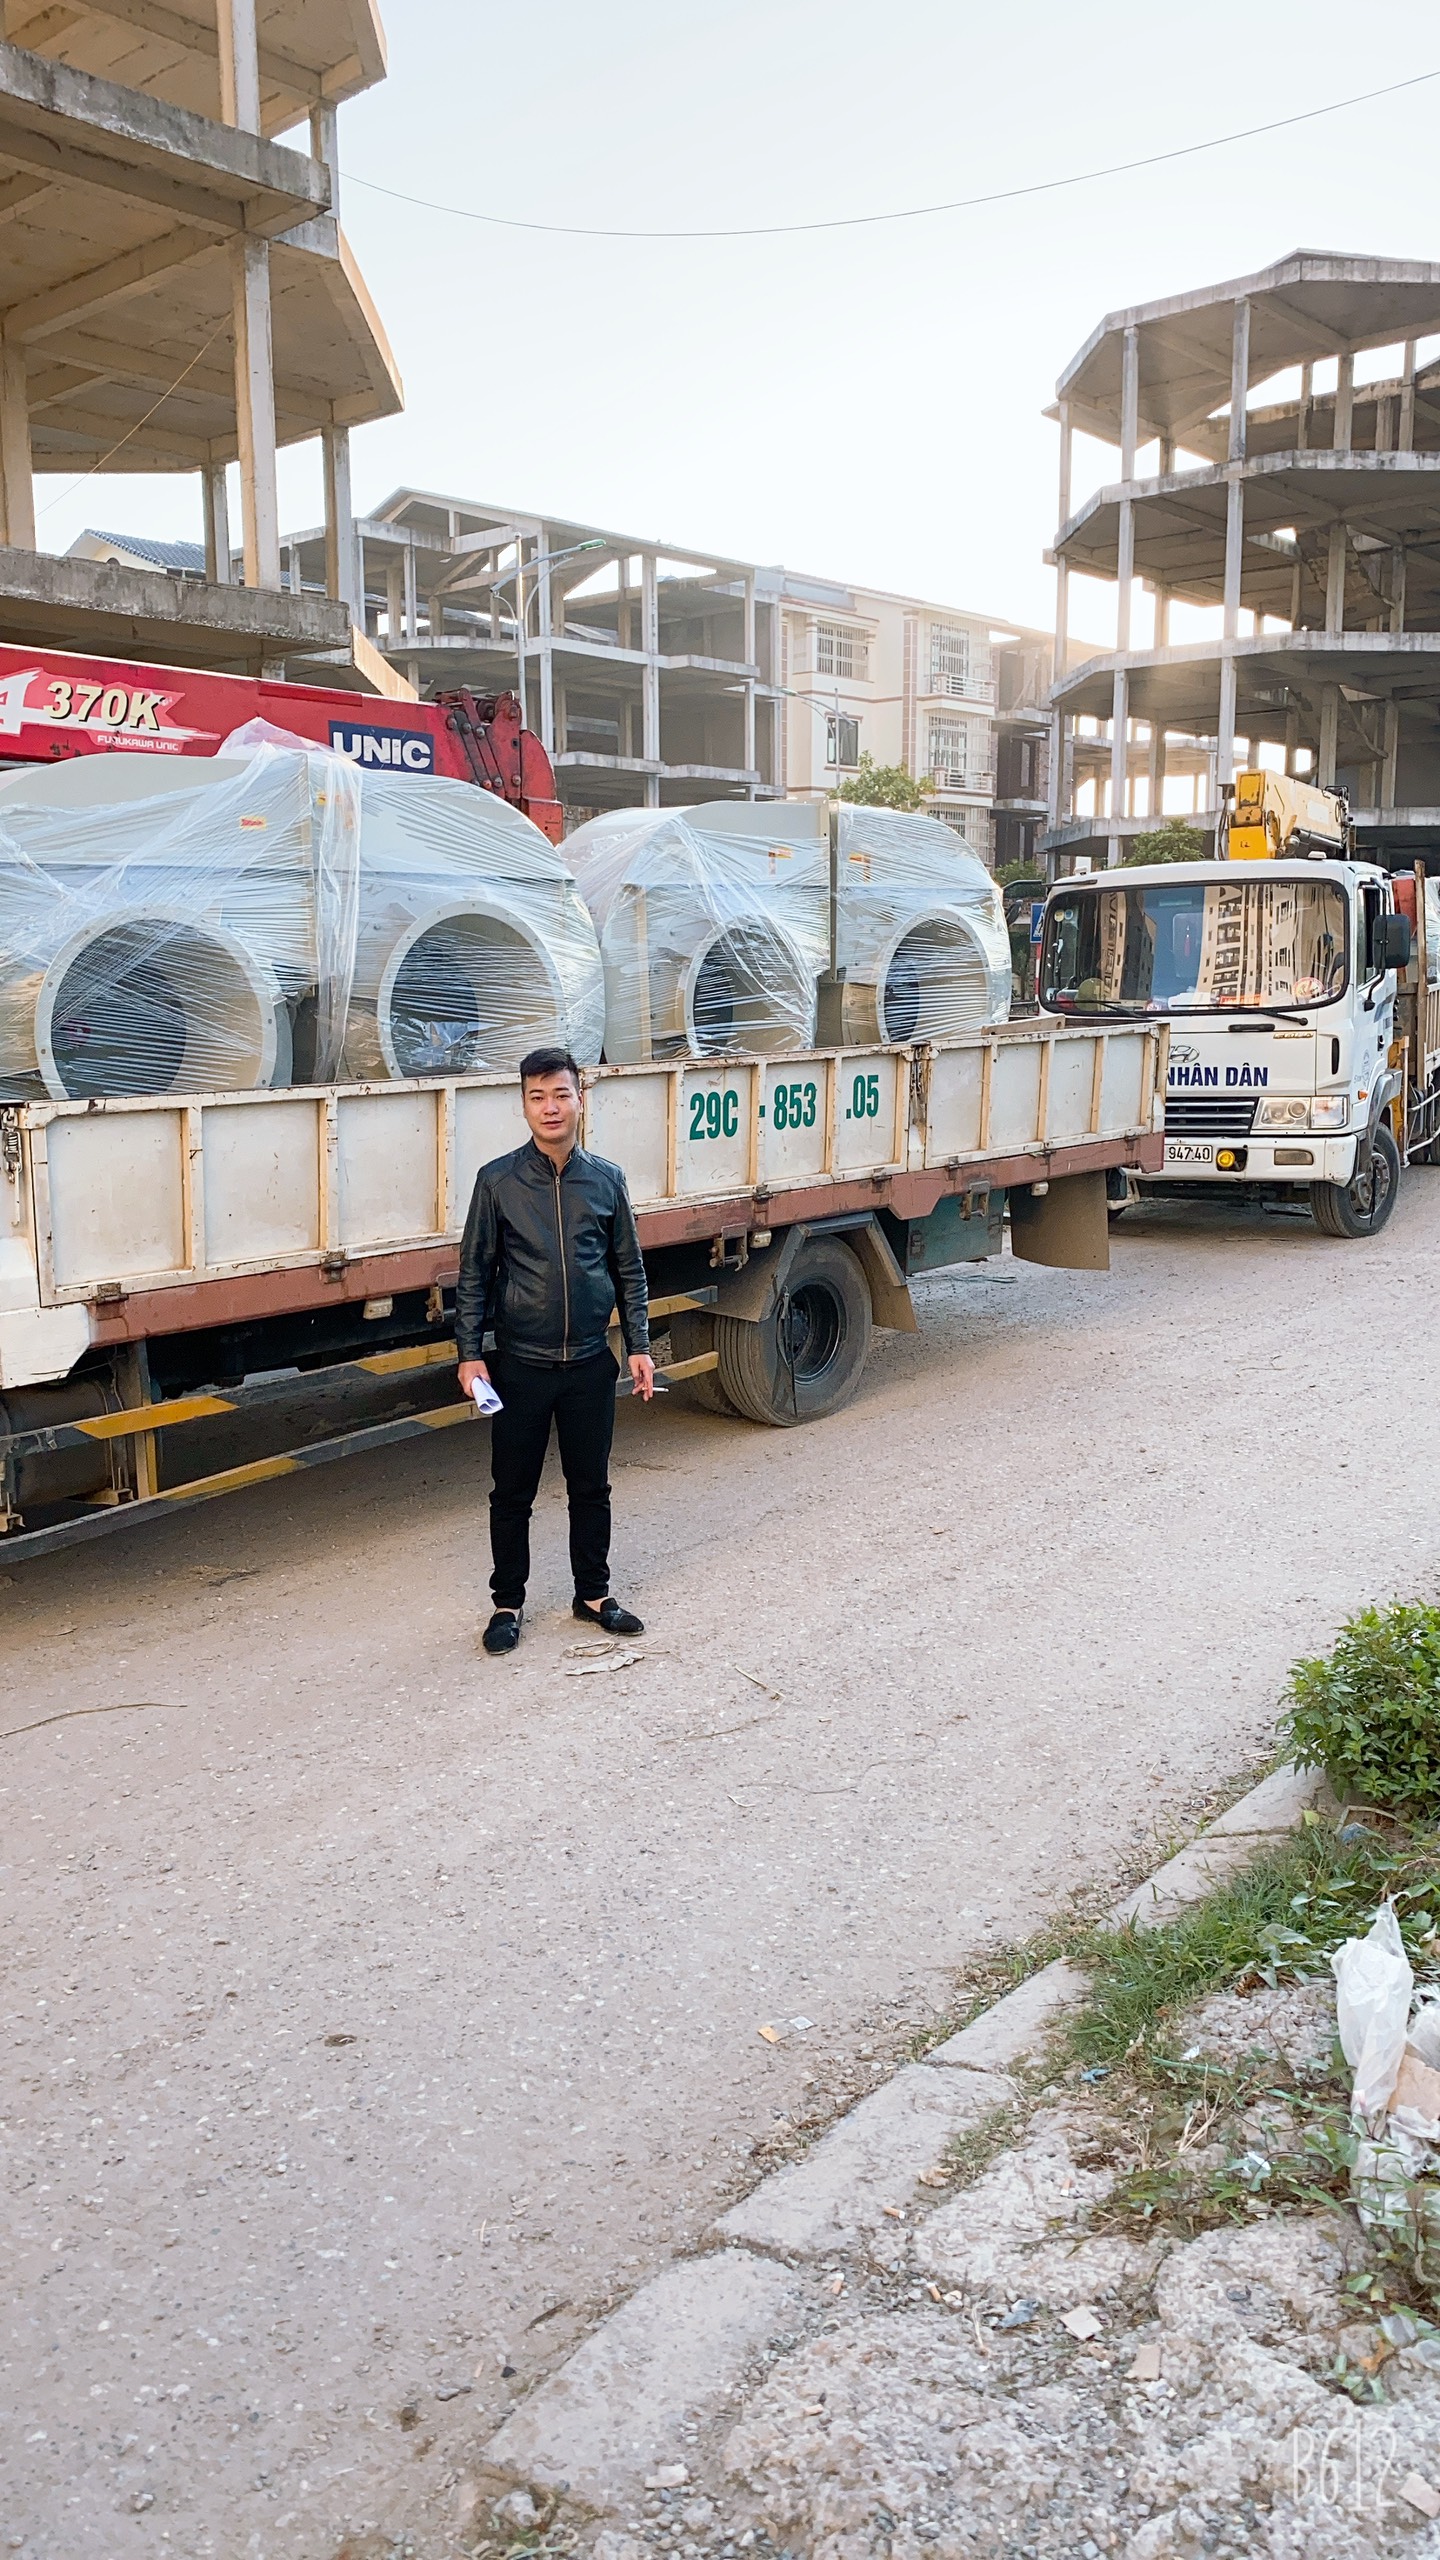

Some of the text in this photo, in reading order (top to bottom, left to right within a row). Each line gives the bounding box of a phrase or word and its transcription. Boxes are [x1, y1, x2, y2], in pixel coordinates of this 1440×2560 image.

[43, 681, 165, 731] 370K
[156, 741, 179, 751] UNIC
[333, 731, 431, 769] UNIC
[1225, 1062, 1269, 1087] DÂN
[689, 1090, 739, 1140] 29C
